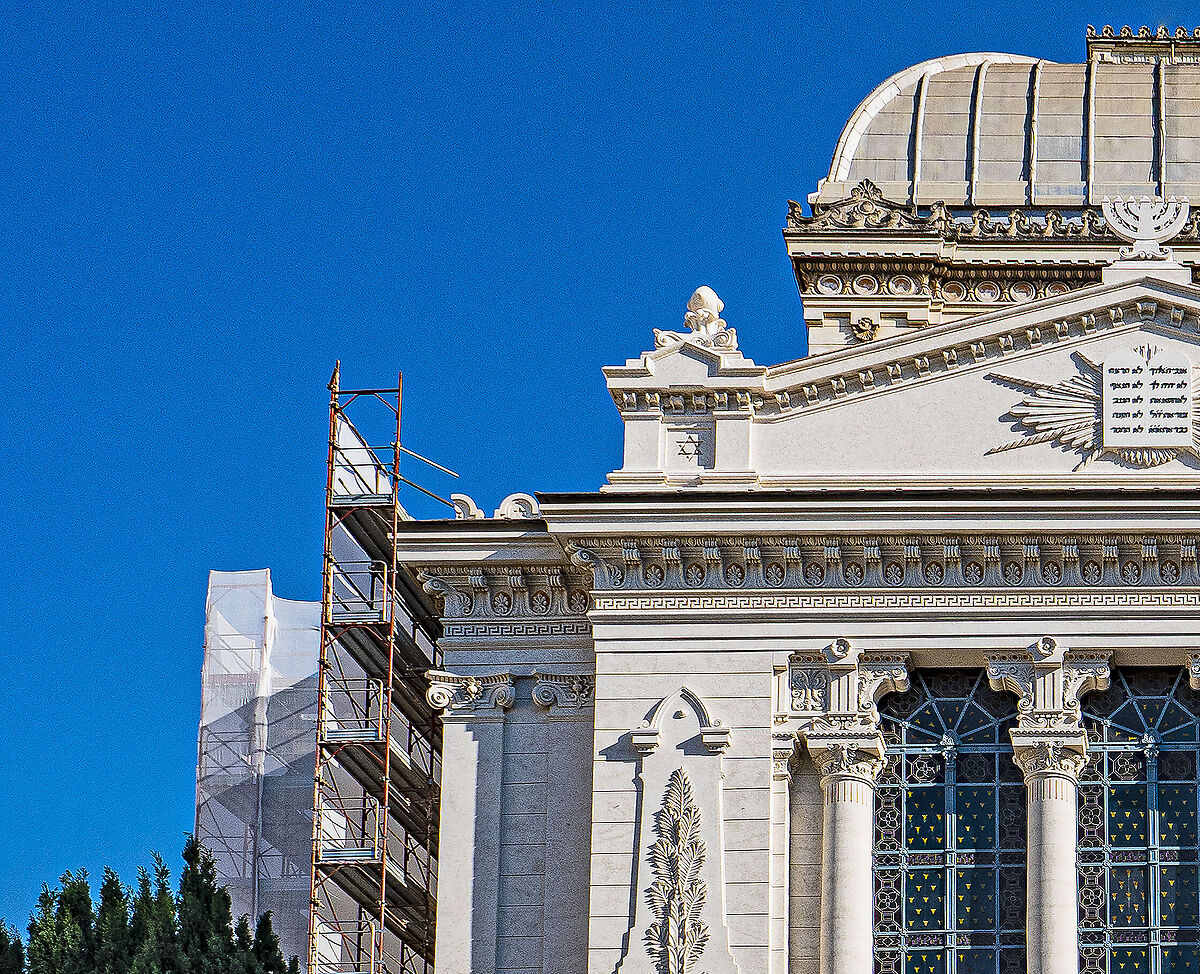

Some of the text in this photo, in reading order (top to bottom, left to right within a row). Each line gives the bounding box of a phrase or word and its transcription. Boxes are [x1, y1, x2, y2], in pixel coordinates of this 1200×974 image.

[1132, 365, 1144, 375] לא
[1132, 379, 1144, 390] לא
[1176, 379, 1188, 390] לא
[1132, 394, 1144, 405] לא
[1132, 409, 1144, 419] לא
[1132, 424, 1145, 434] לא
